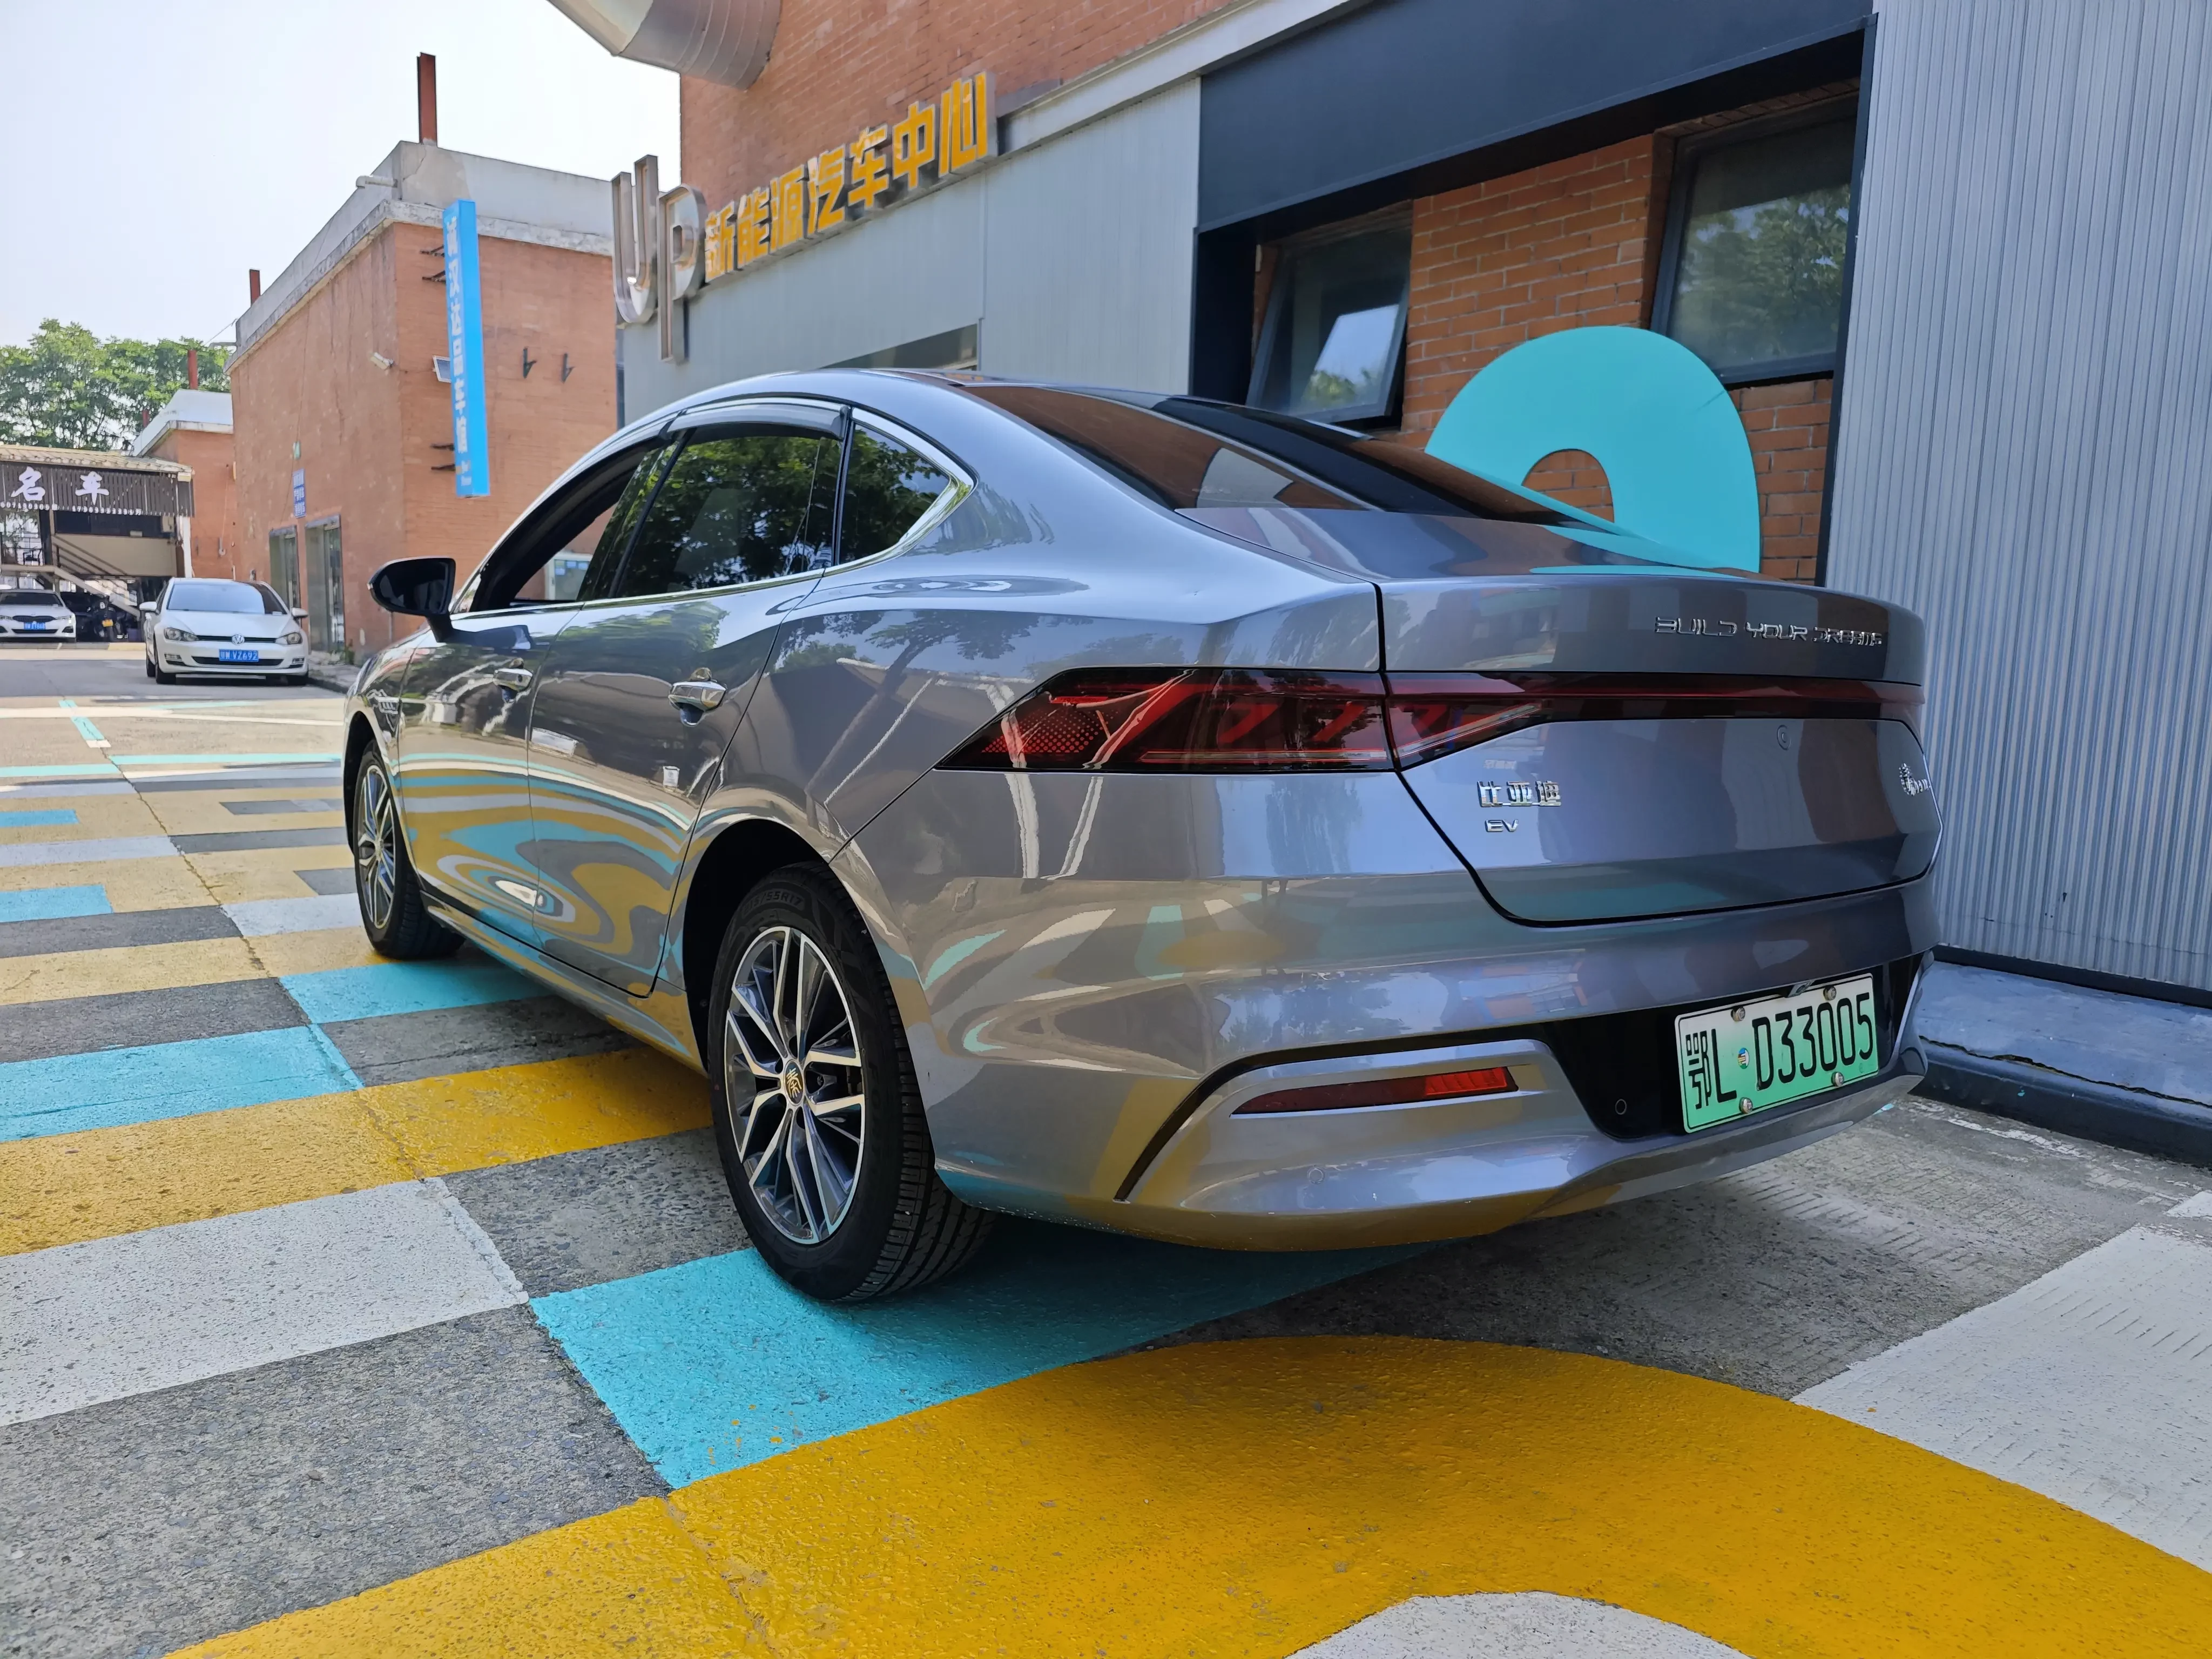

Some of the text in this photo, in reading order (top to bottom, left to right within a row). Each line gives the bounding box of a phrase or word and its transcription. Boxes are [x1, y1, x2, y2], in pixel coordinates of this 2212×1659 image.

[705, 71, 993, 283] 新能源汽车中心
[1655, 617, 1882, 646] BUILD YOUR DREAMS
[1477, 780, 1561, 807] 比亚迪
[1485, 819, 1519, 832] EV
